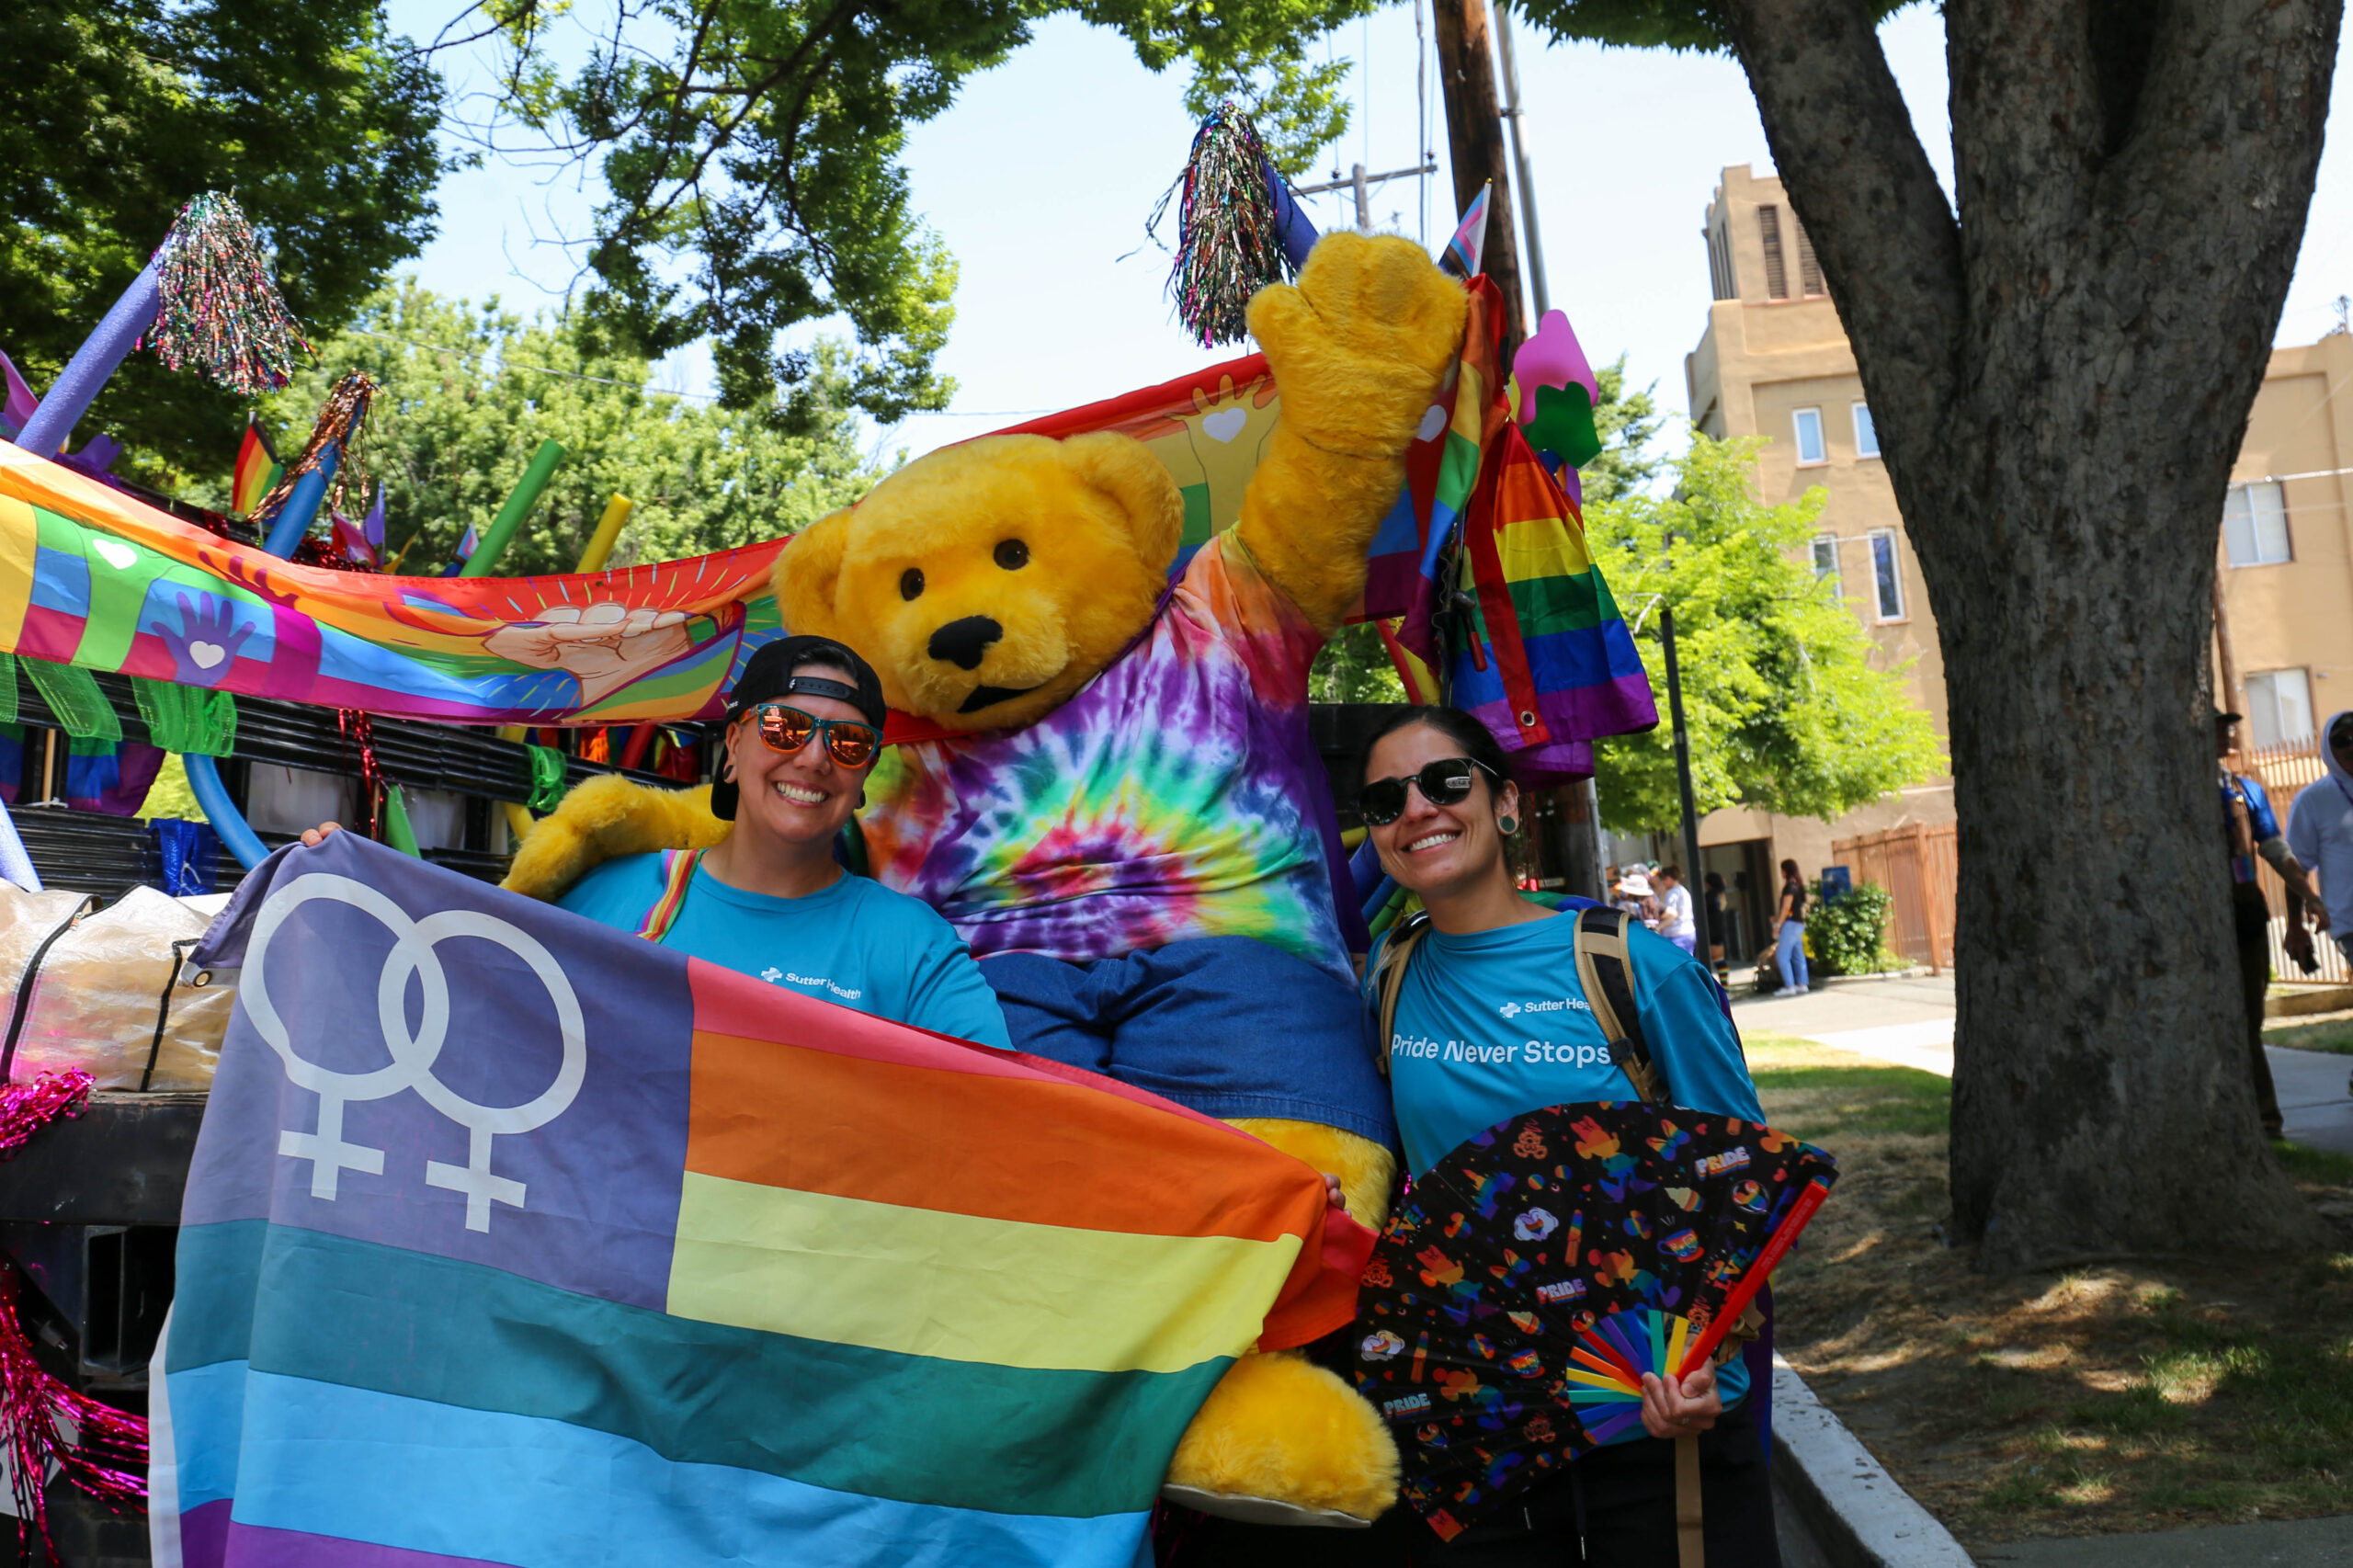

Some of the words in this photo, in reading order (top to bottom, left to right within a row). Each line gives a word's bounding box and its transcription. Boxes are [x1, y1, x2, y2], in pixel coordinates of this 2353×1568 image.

[786, 971, 826, 986] Sutter
[826, 979, 860, 1000] Health
[1524, 999, 1564, 1013] Sutter
[1565, 997, 1591, 1011] Hea
[1391, 1033, 1439, 1060] Pride
[1443, 1040, 1518, 1063] Never
[1523, 1040, 1611, 1069] Stops
[1694, 1146, 1750, 1177] PRIDE
[1536, 1278, 1587, 1303] PRIDE
[1382, 1392, 1431, 1417] PRIDE
